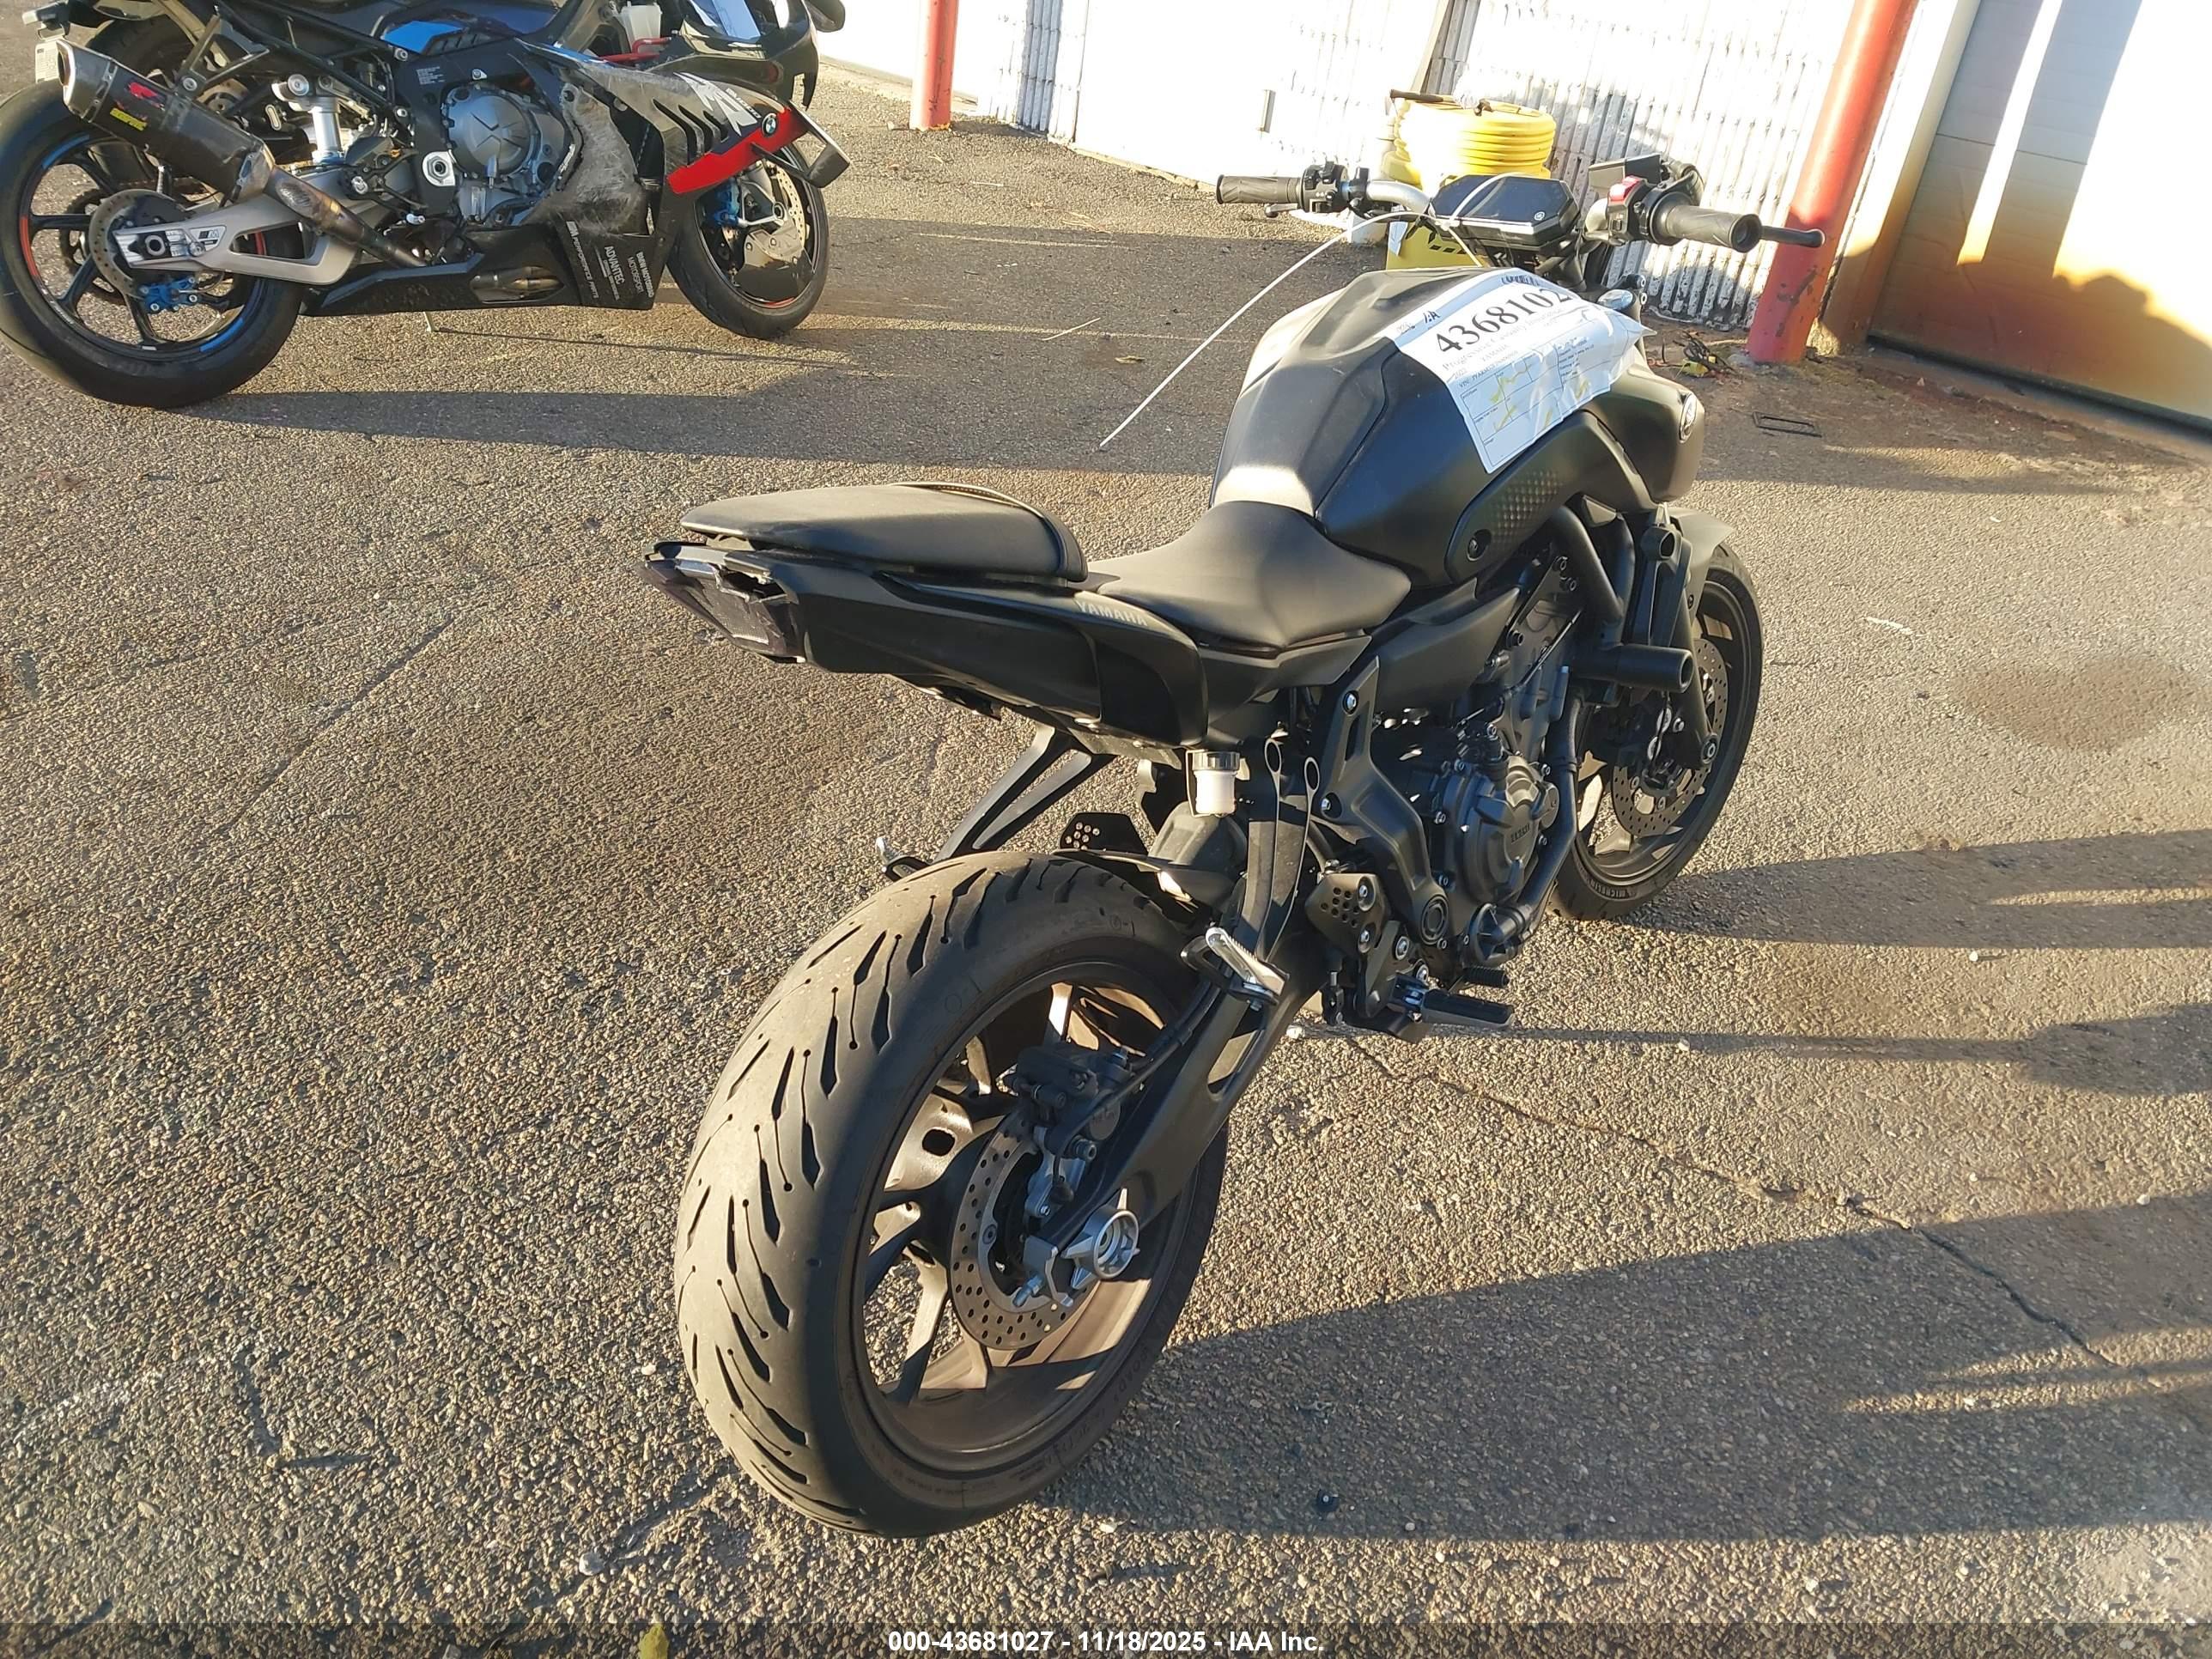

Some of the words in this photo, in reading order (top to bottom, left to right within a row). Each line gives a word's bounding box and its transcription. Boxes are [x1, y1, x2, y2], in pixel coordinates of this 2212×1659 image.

[573, 236, 592, 280] PERFORMANCE
[588, 281, 599, 299] PARTS
[604, 245, 626, 285] ADVANTEC
[627, 256, 645, 293] MOTORSPORT
[636, 251, 647, 268] BMW
[641, 267, 655, 298] MOTORRAD
[1073, 599, 1149, 627] YAMAHA
[1589, 878, 1626, 898] MICHELIN
